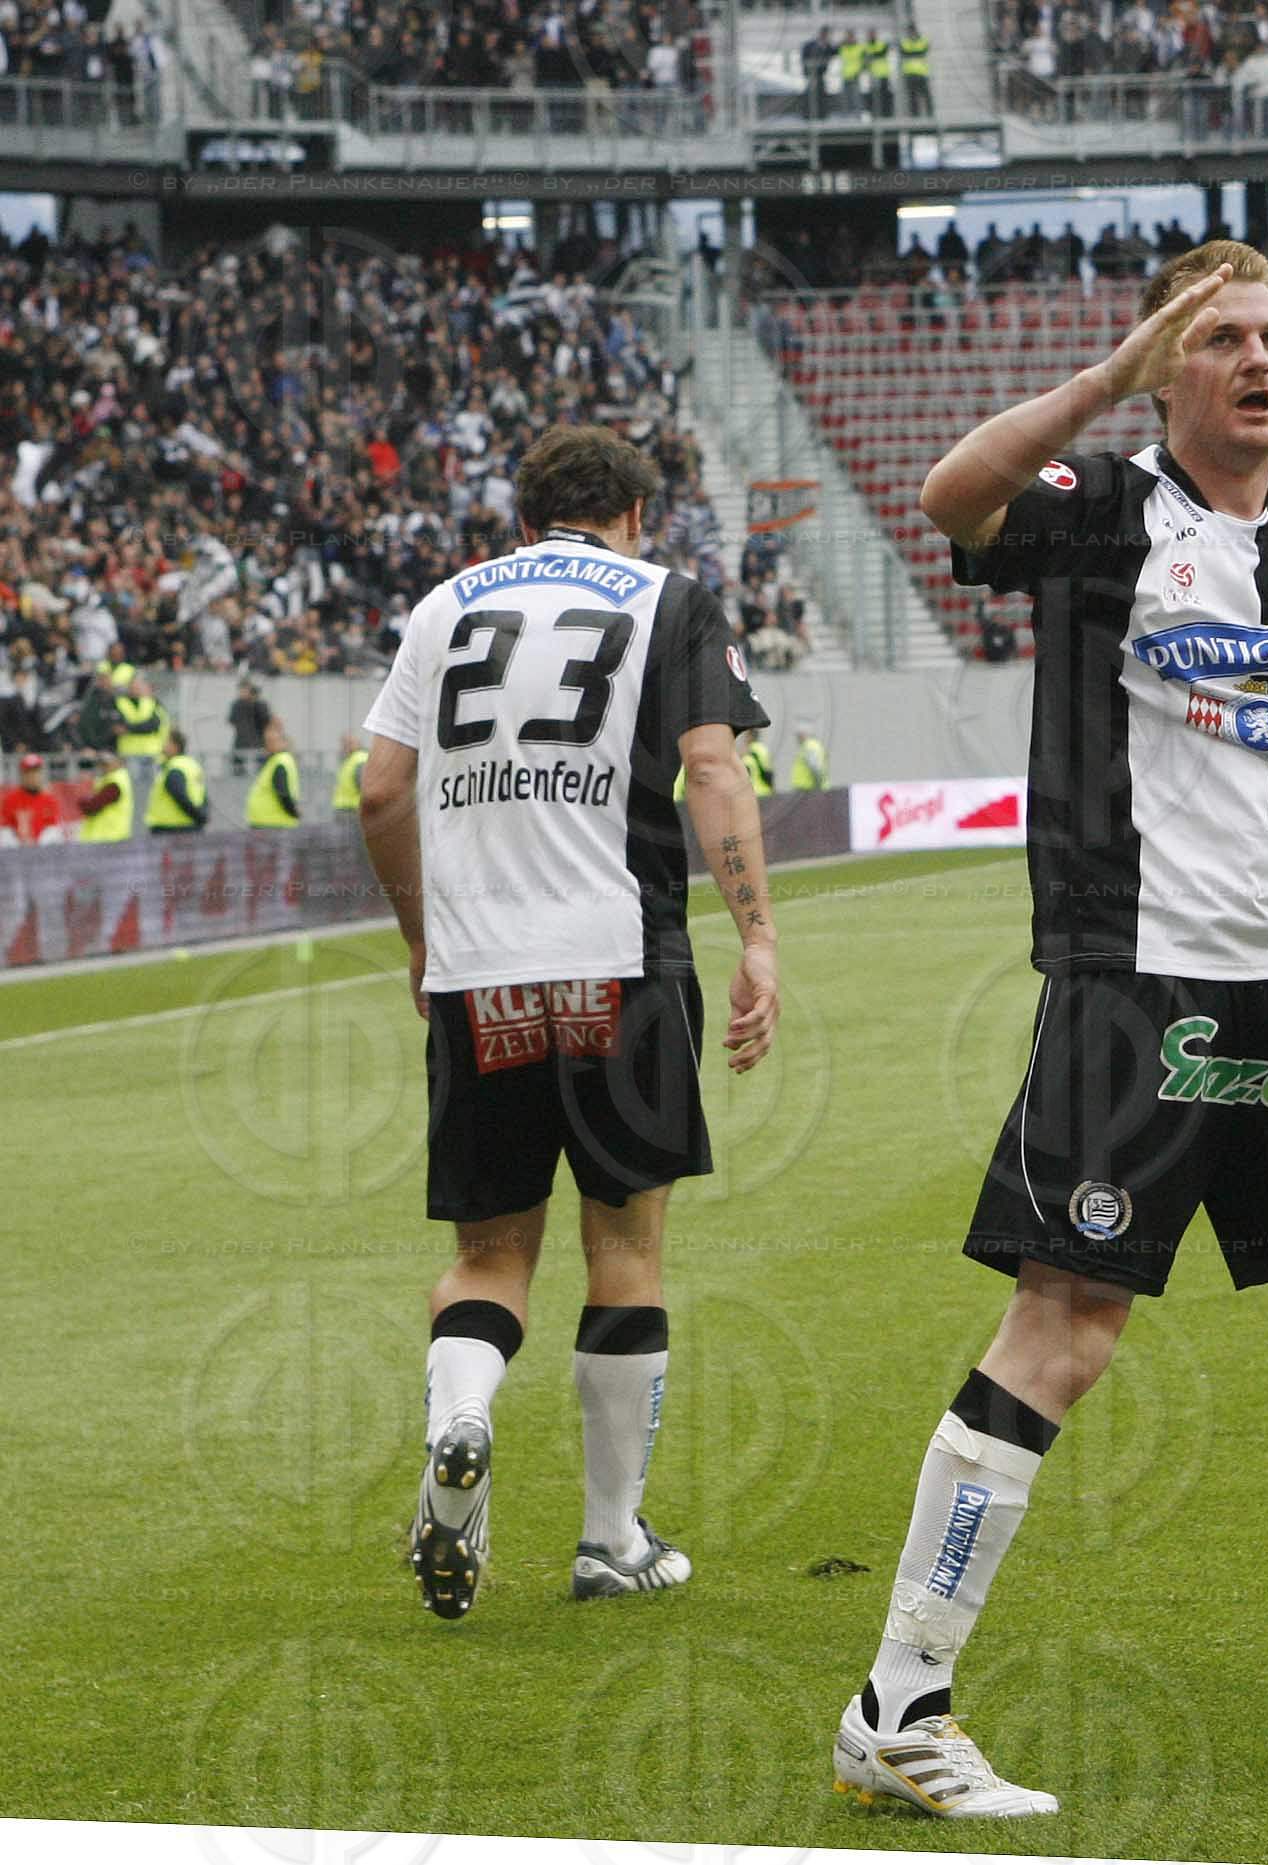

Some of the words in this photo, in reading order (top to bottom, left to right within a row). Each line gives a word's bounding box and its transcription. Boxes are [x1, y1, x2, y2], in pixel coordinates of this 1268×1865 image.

[460, 559, 639, 599] PUNTIGAMER
[437, 608, 638, 753] 23
[440, 760, 615, 810] schildenfeld
